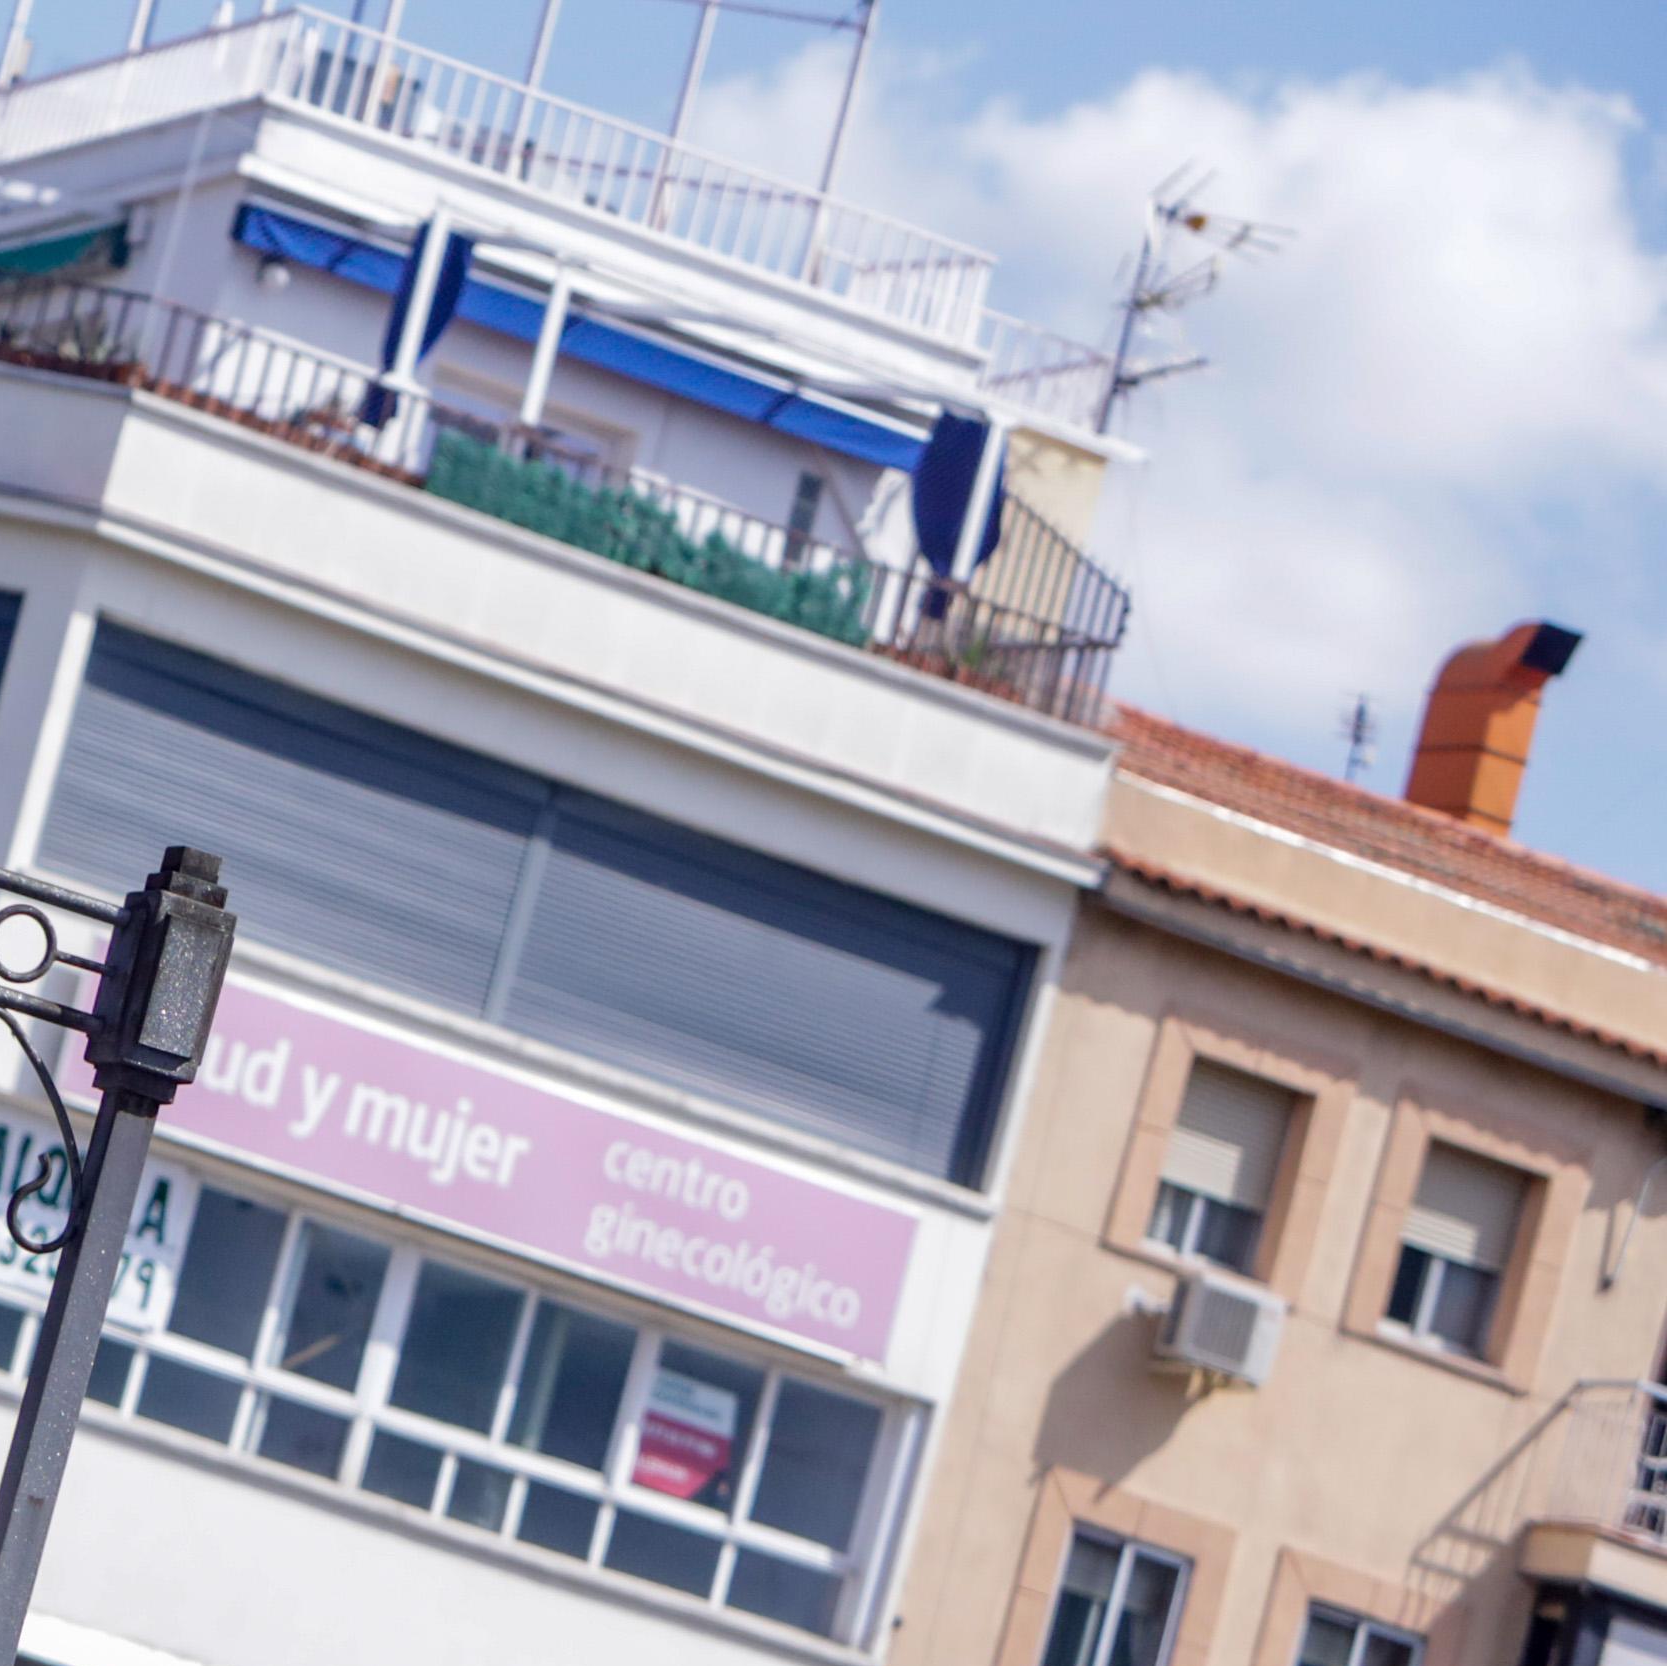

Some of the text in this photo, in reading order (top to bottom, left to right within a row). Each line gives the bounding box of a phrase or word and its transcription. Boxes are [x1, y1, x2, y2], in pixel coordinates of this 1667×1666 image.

[288, 1063, 341, 1141] y
[345, 1082, 534, 1189] mujer
[604, 1136, 750, 1222] centro
[584, 1199, 863, 1330] ginecológico
